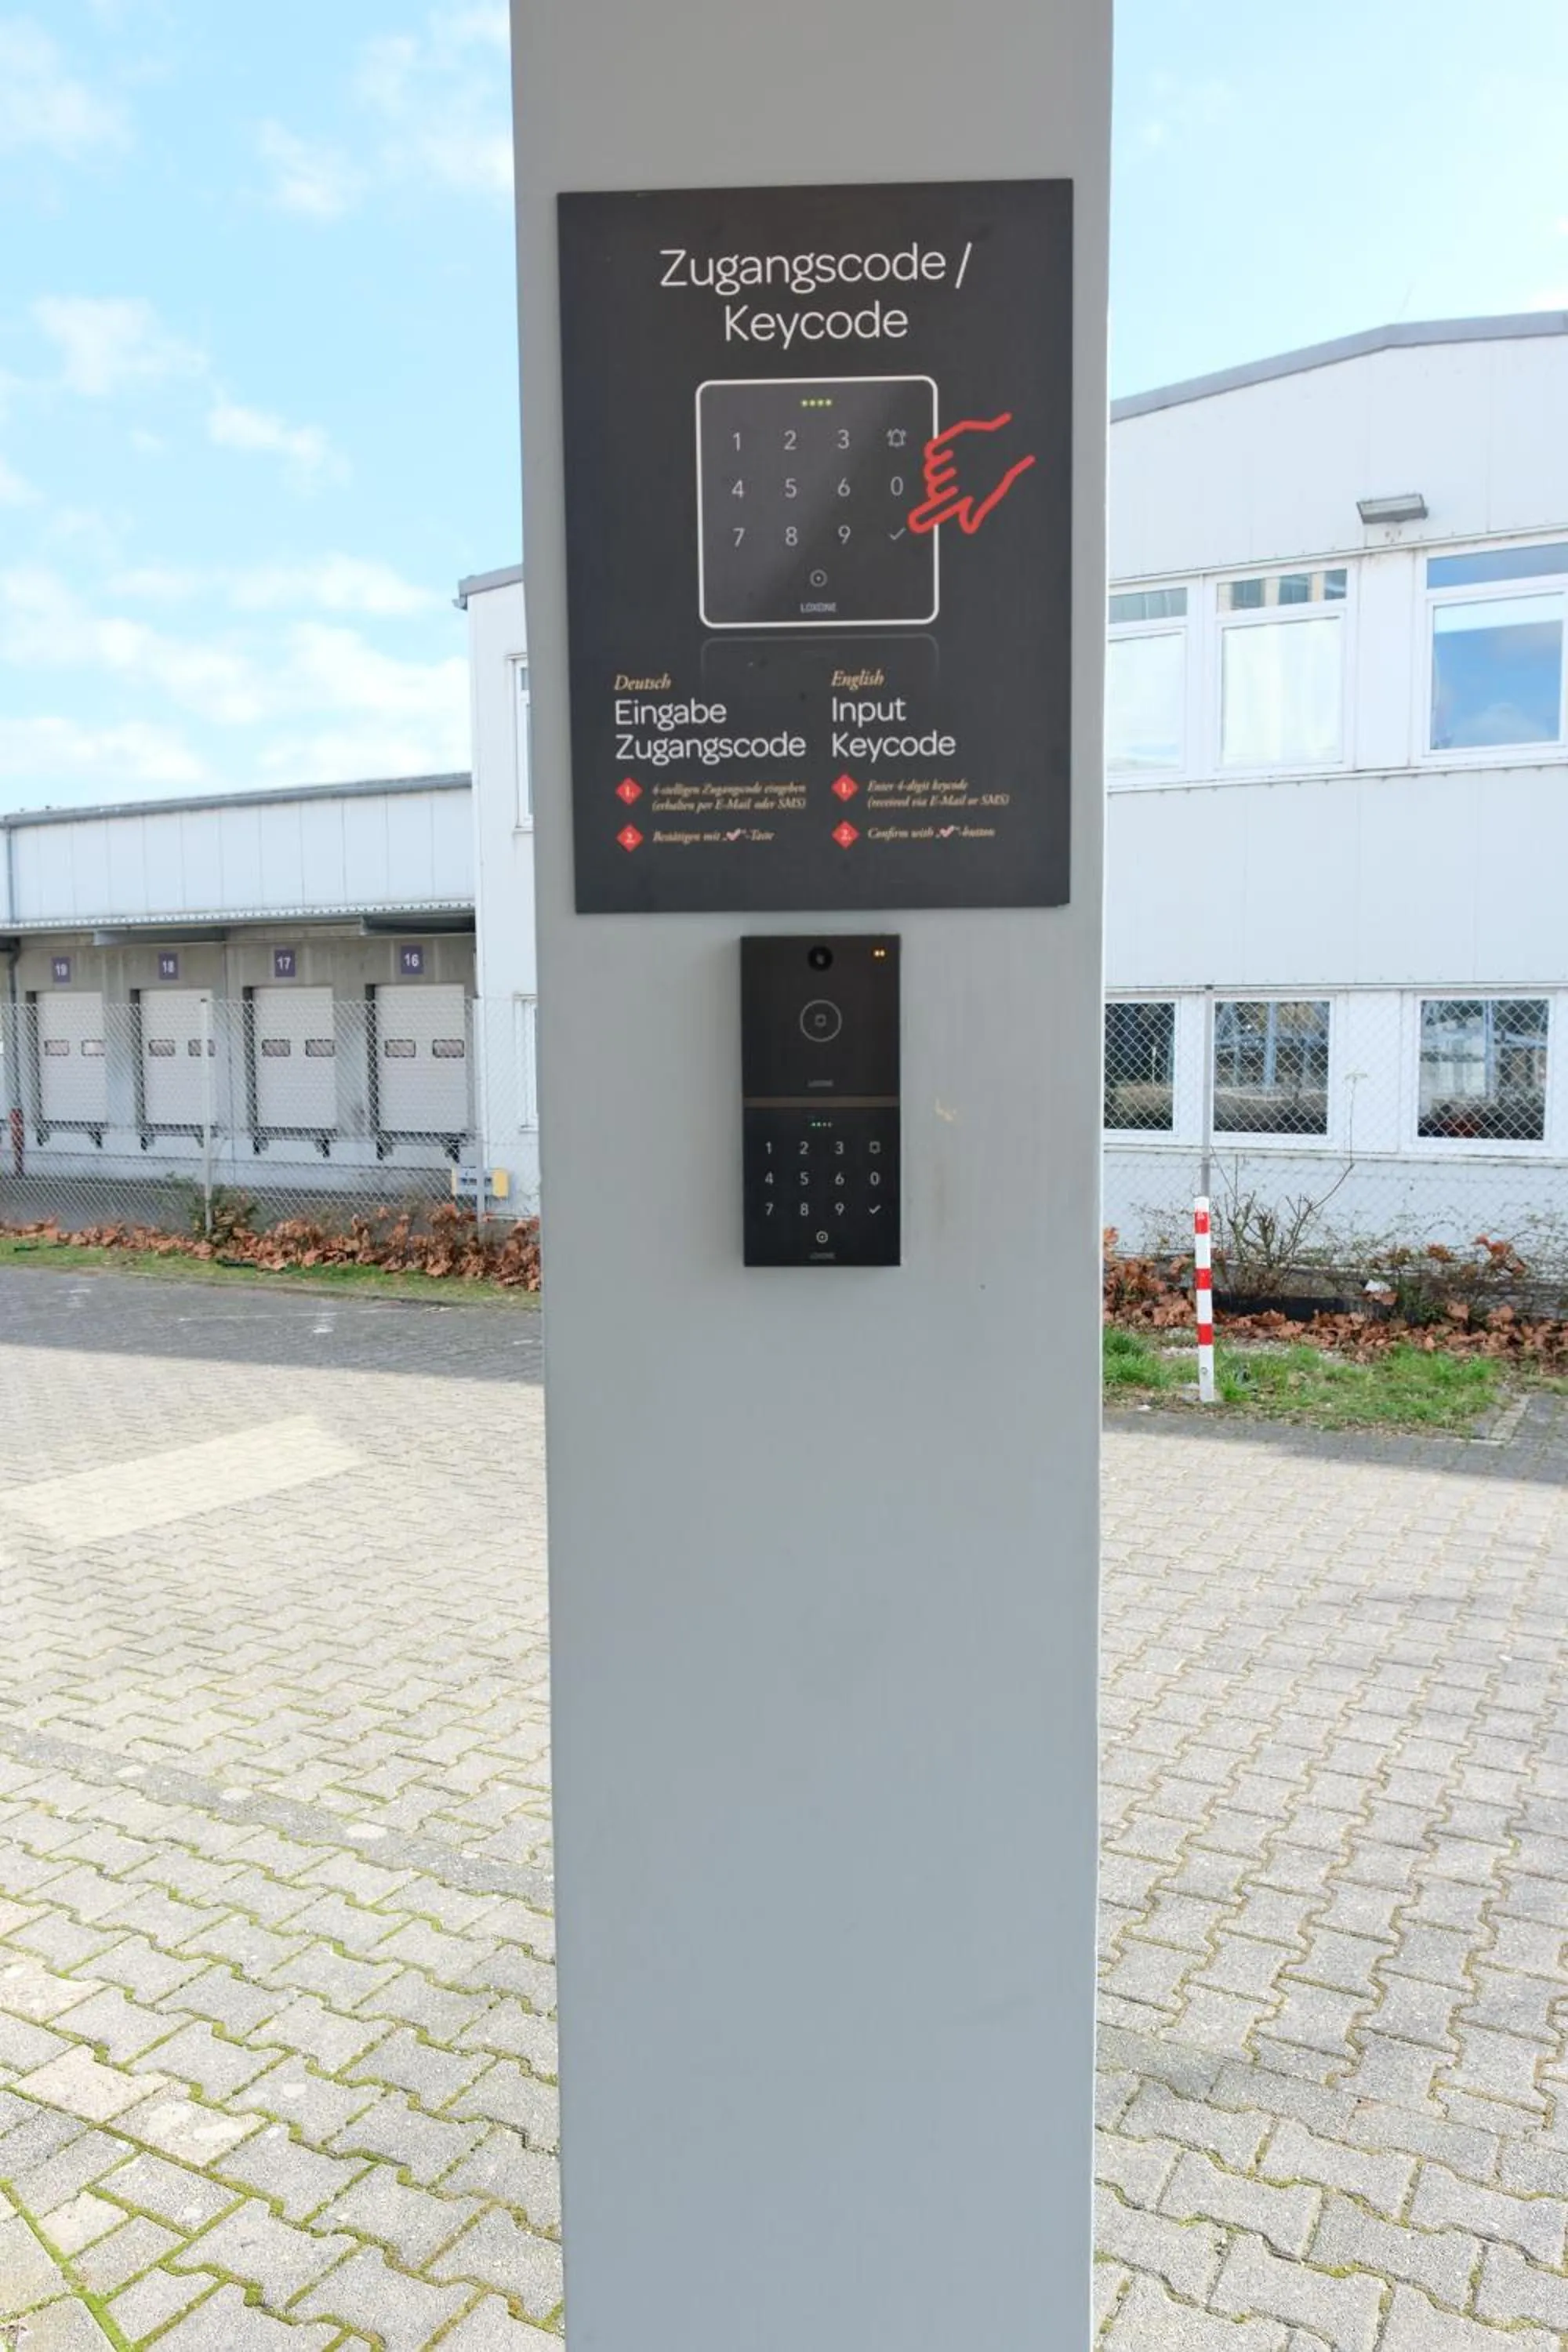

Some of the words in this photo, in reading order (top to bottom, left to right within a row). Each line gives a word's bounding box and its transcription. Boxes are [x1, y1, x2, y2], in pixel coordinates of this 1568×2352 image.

[660, 242, 946, 296] Zugangscode
[725, 300, 908, 350] Keycode
[733, 432, 741, 451] 1
[784, 430, 797, 450] 2
[837, 429, 850, 449] 3
[731, 480, 744, 498] 4
[785, 477, 797, 498] 5
[837, 477, 851, 496] 6
[890, 476, 904, 496] 0
[733, 527, 745, 546] 7
[786, 526, 798, 546] 8
[838, 525, 851, 543] 9
[614, 672, 672, 692] Deutsch
[830, 670, 885, 691] English
[615, 698, 728, 731] Eingabe
[831, 697, 907, 728] Input
[615, 732, 807, 766] Zugangscode
[831, 730, 956, 763] Keycode
[278, 956, 291, 969] 17
[405, 954, 419, 967] 16
[766, 1142, 771, 1154] 1
[800, 1141, 809, 1155] 2
[835, 1141, 844, 1155] 3
[764, 1172, 774, 1184] 4
[800, 1171, 809, 1185] 5
[835, 1173, 844, 1185] 6
[869, 1171, 880, 1186] 0
[766, 1203, 774, 1215] 7
[800, 1202, 809, 1216] 8
[835, 1202, 845, 1216] 9
